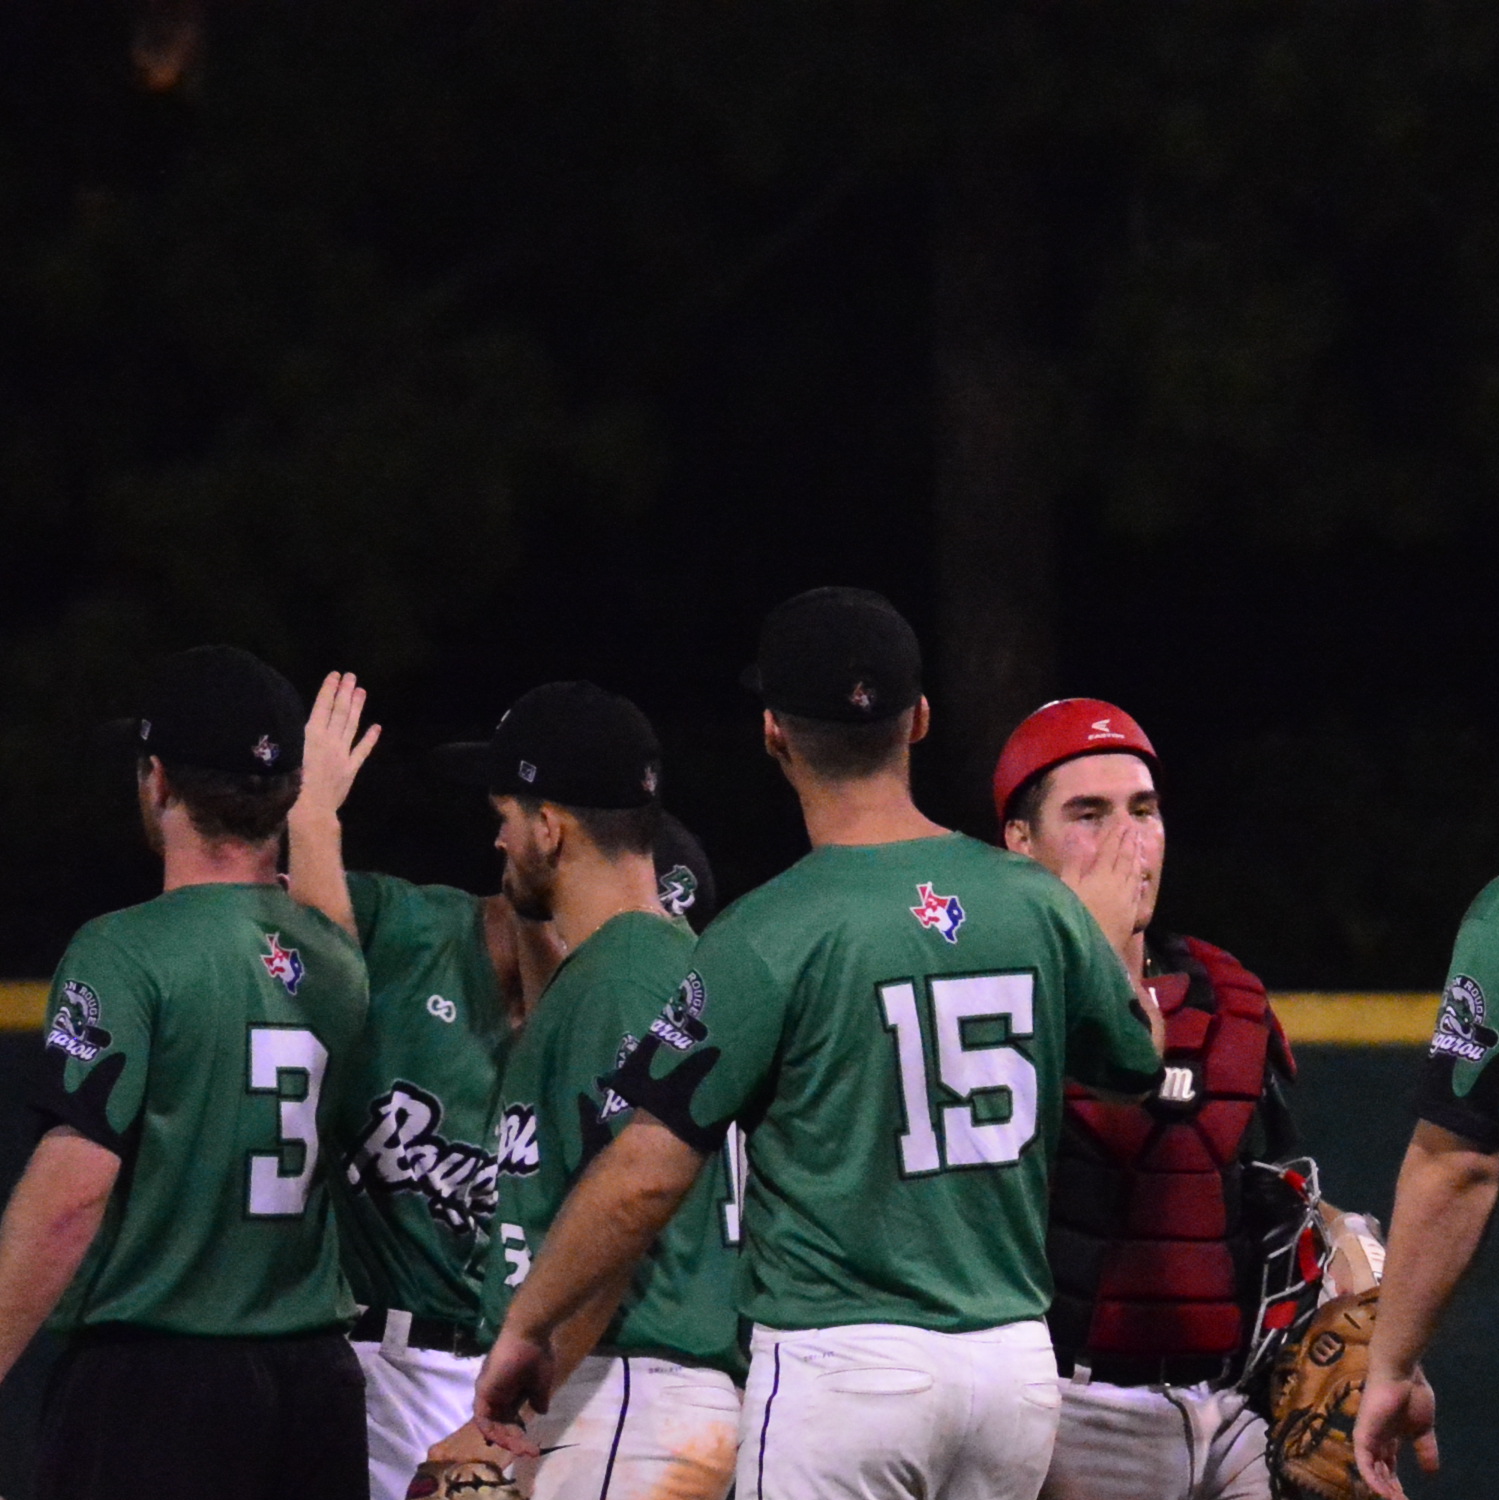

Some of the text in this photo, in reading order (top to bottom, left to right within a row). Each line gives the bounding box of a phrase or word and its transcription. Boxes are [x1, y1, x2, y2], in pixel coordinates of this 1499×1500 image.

[248, 1027, 329, 1216] 3
[879, 972, 1040, 1174] 15
[1429, 1034, 1485, 1060] garou
